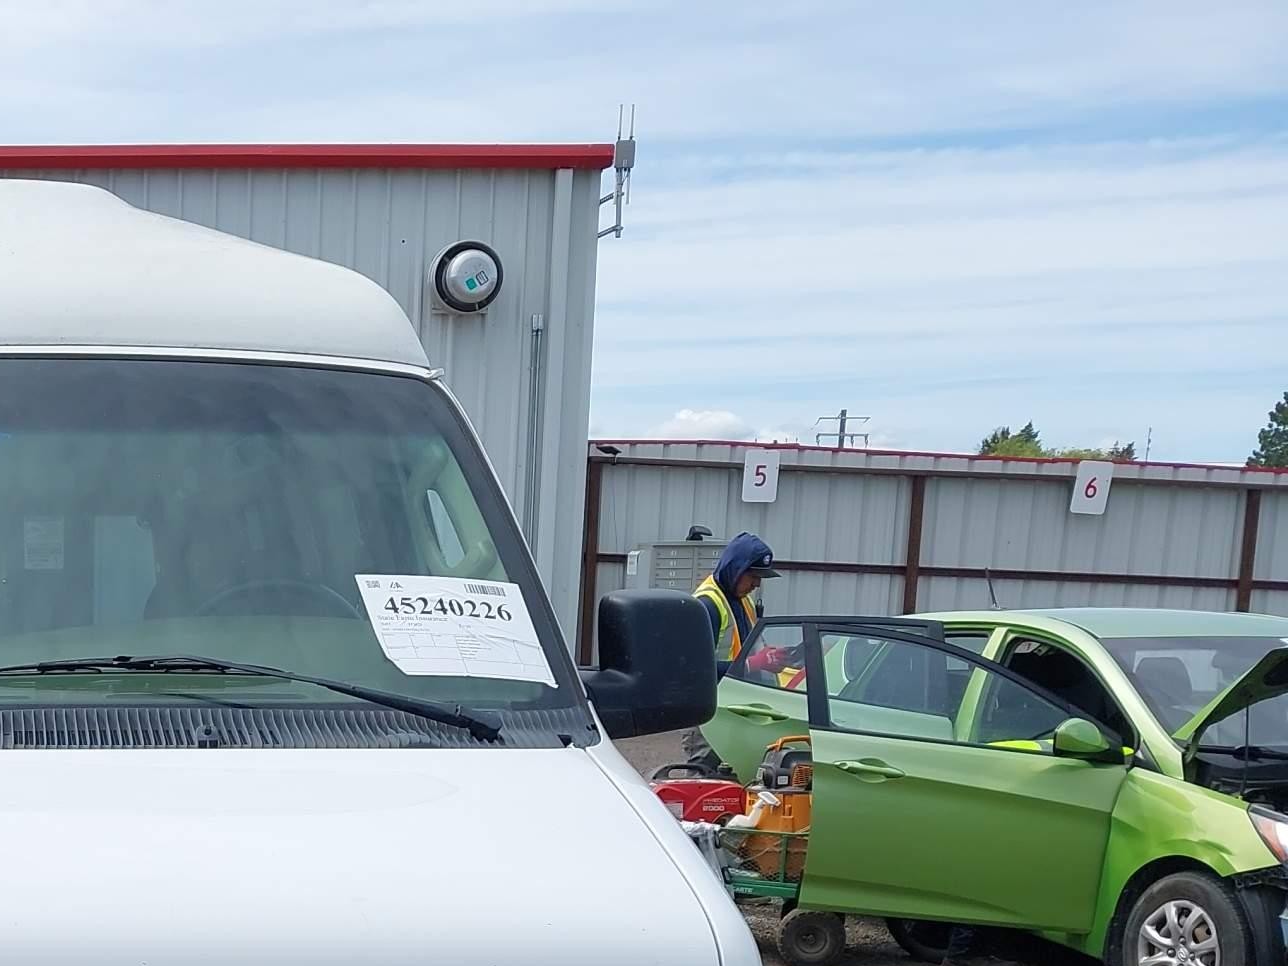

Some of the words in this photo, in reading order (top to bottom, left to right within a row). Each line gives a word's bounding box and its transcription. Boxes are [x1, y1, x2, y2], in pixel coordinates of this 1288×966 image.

[754, 464, 767, 487] 5
[1084, 476, 1097, 499] 6
[384, 596, 512, 622] 45240226
